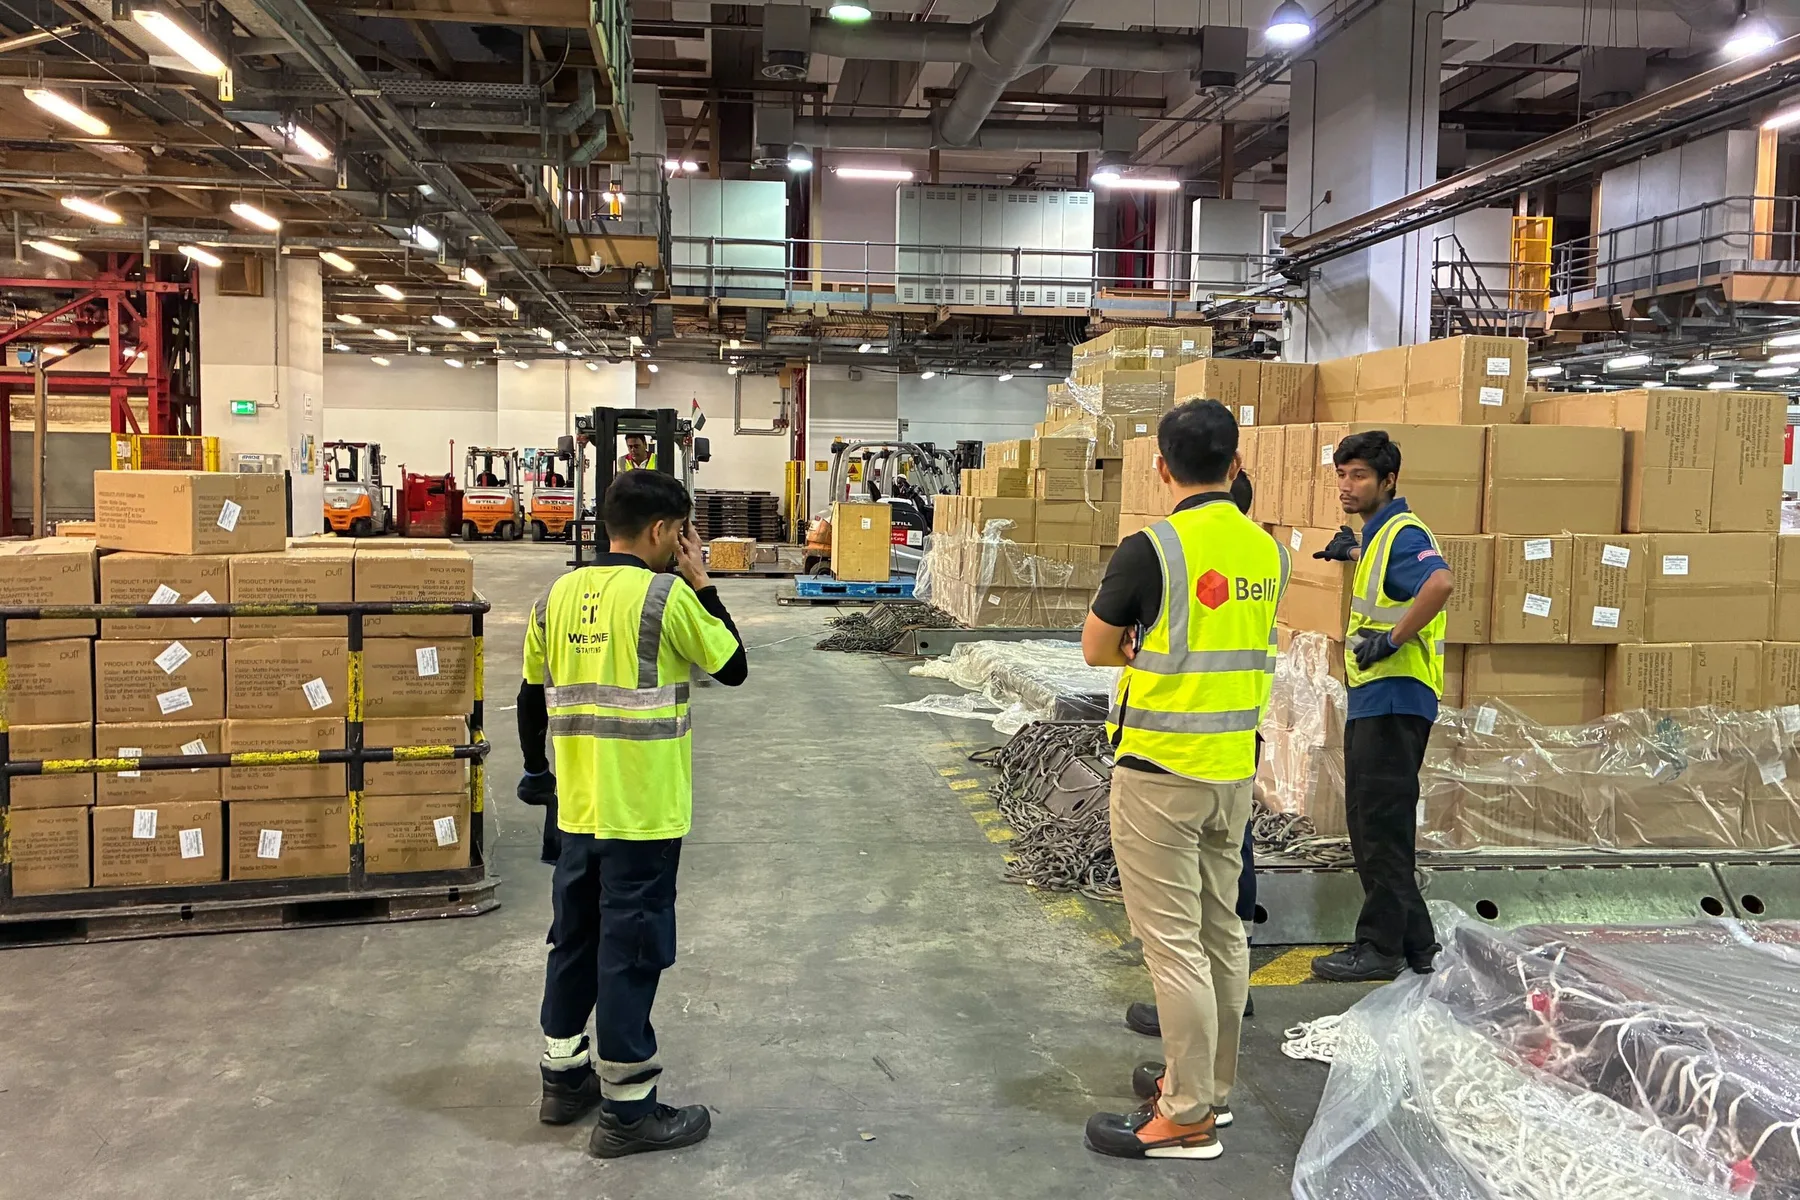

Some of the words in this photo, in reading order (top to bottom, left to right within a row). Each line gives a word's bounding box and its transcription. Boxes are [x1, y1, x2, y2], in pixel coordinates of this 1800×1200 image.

[1235, 577, 1276, 602] Belli
[568, 632, 588, 644] WE
[196, 649, 214, 657] puff
[192, 812, 212, 822] puff
